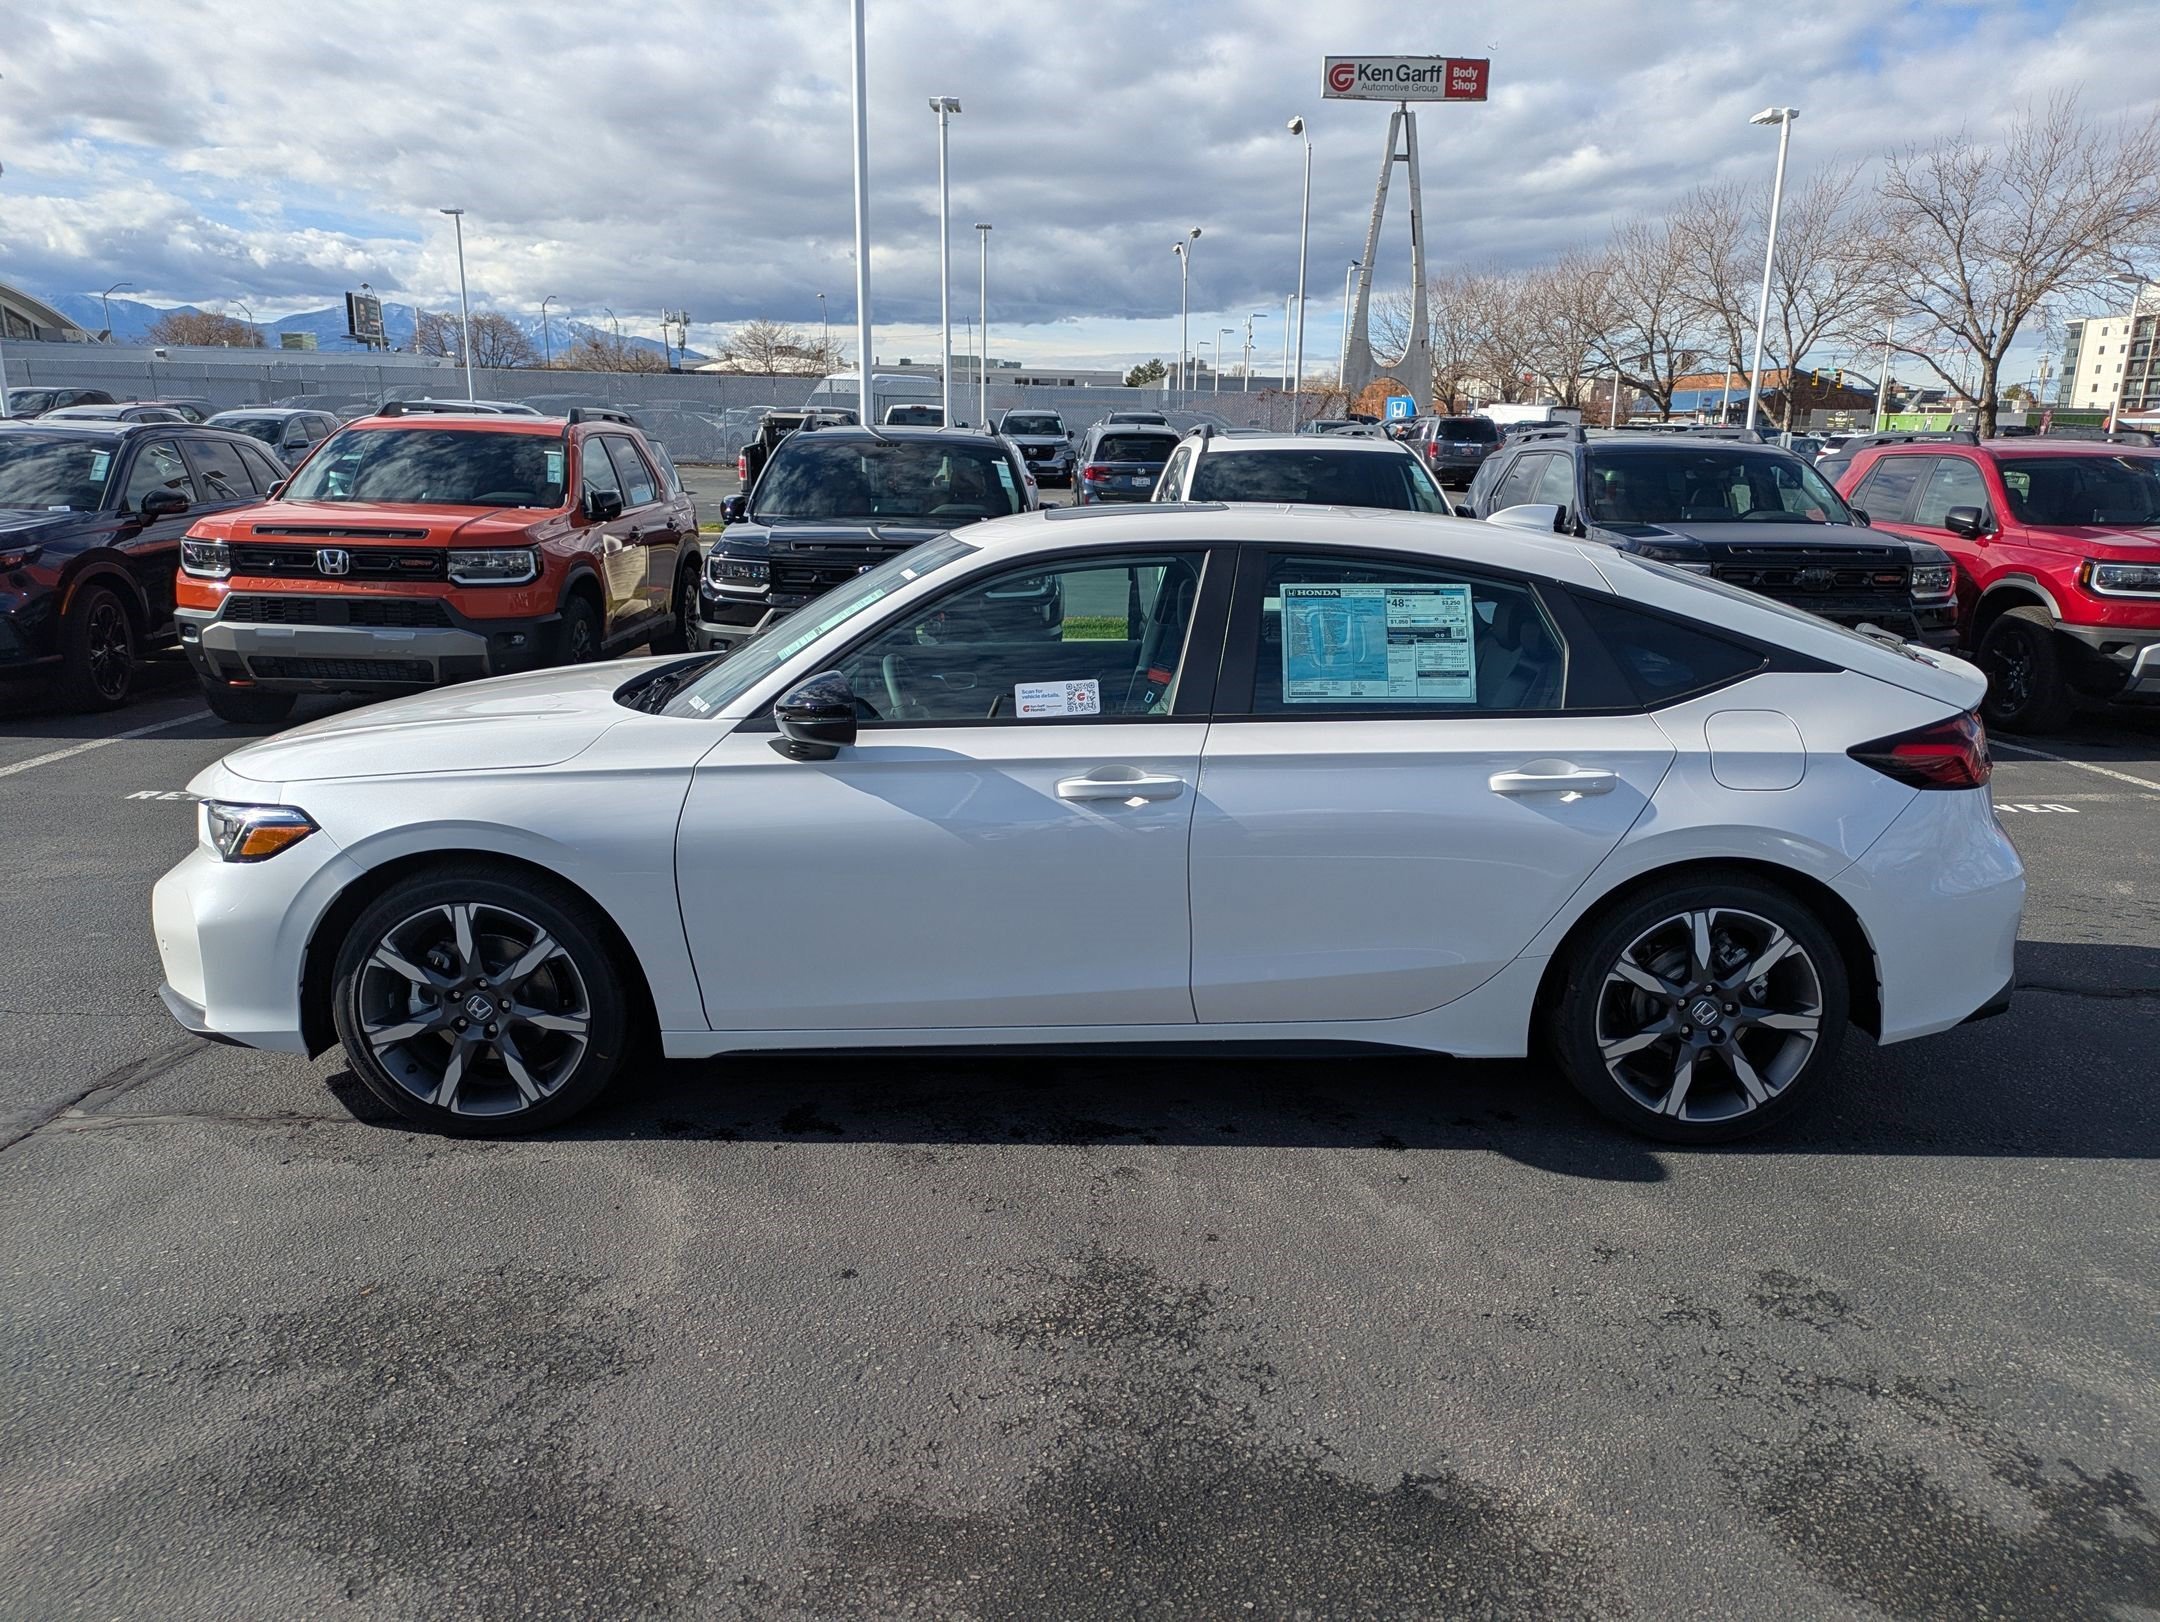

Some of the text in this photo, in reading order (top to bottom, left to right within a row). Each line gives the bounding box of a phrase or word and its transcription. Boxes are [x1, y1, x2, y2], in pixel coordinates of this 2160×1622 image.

[1358, 63, 1443, 83] Ken Garff
[1452, 67, 1479, 80] Body
[1361, 83, 1439, 94] Automotive Group
[1452, 79, 1478, 93] Shop
[1391, 598, 1405, 608] 48
